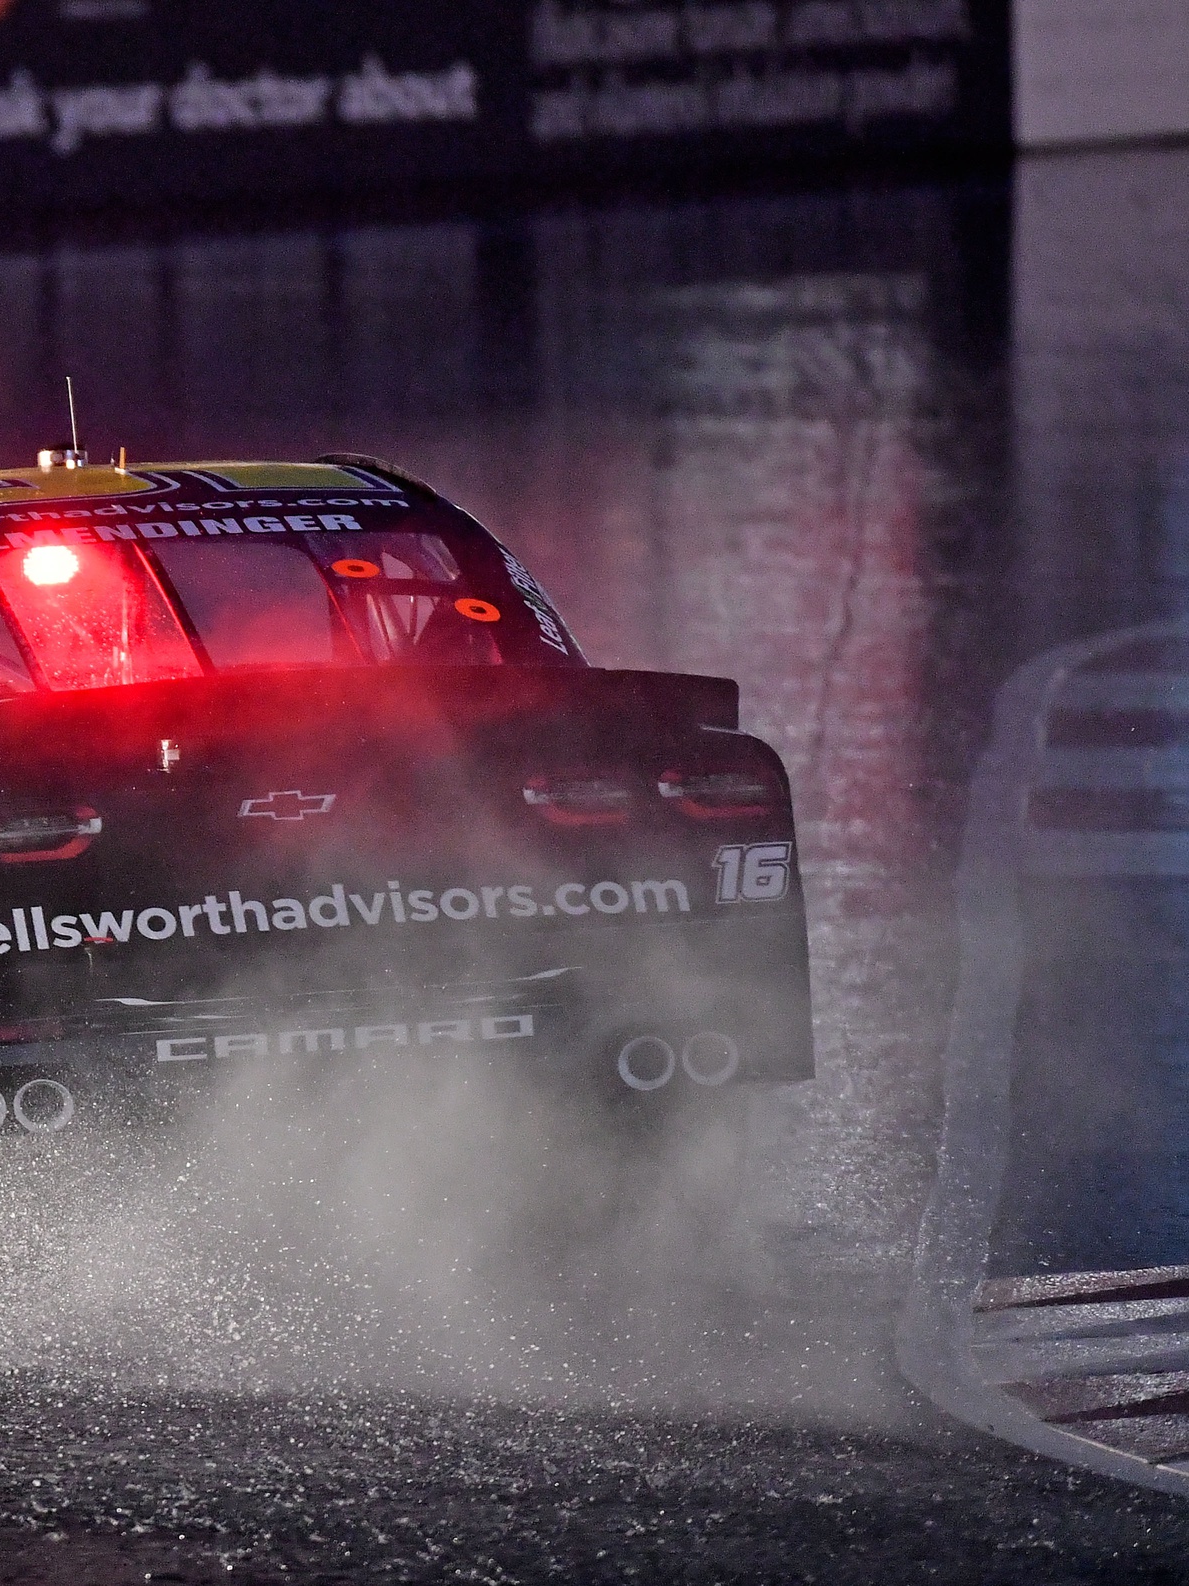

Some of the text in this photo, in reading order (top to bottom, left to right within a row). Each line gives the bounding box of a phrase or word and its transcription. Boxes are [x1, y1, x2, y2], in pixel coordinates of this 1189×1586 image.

[51, 84, 161, 156] your
[171, 60, 329, 132] doctor
[339, 51, 477, 122] about
[711, 841, 793, 905] 16
[155, 1013, 534, 1063] CAMARO
